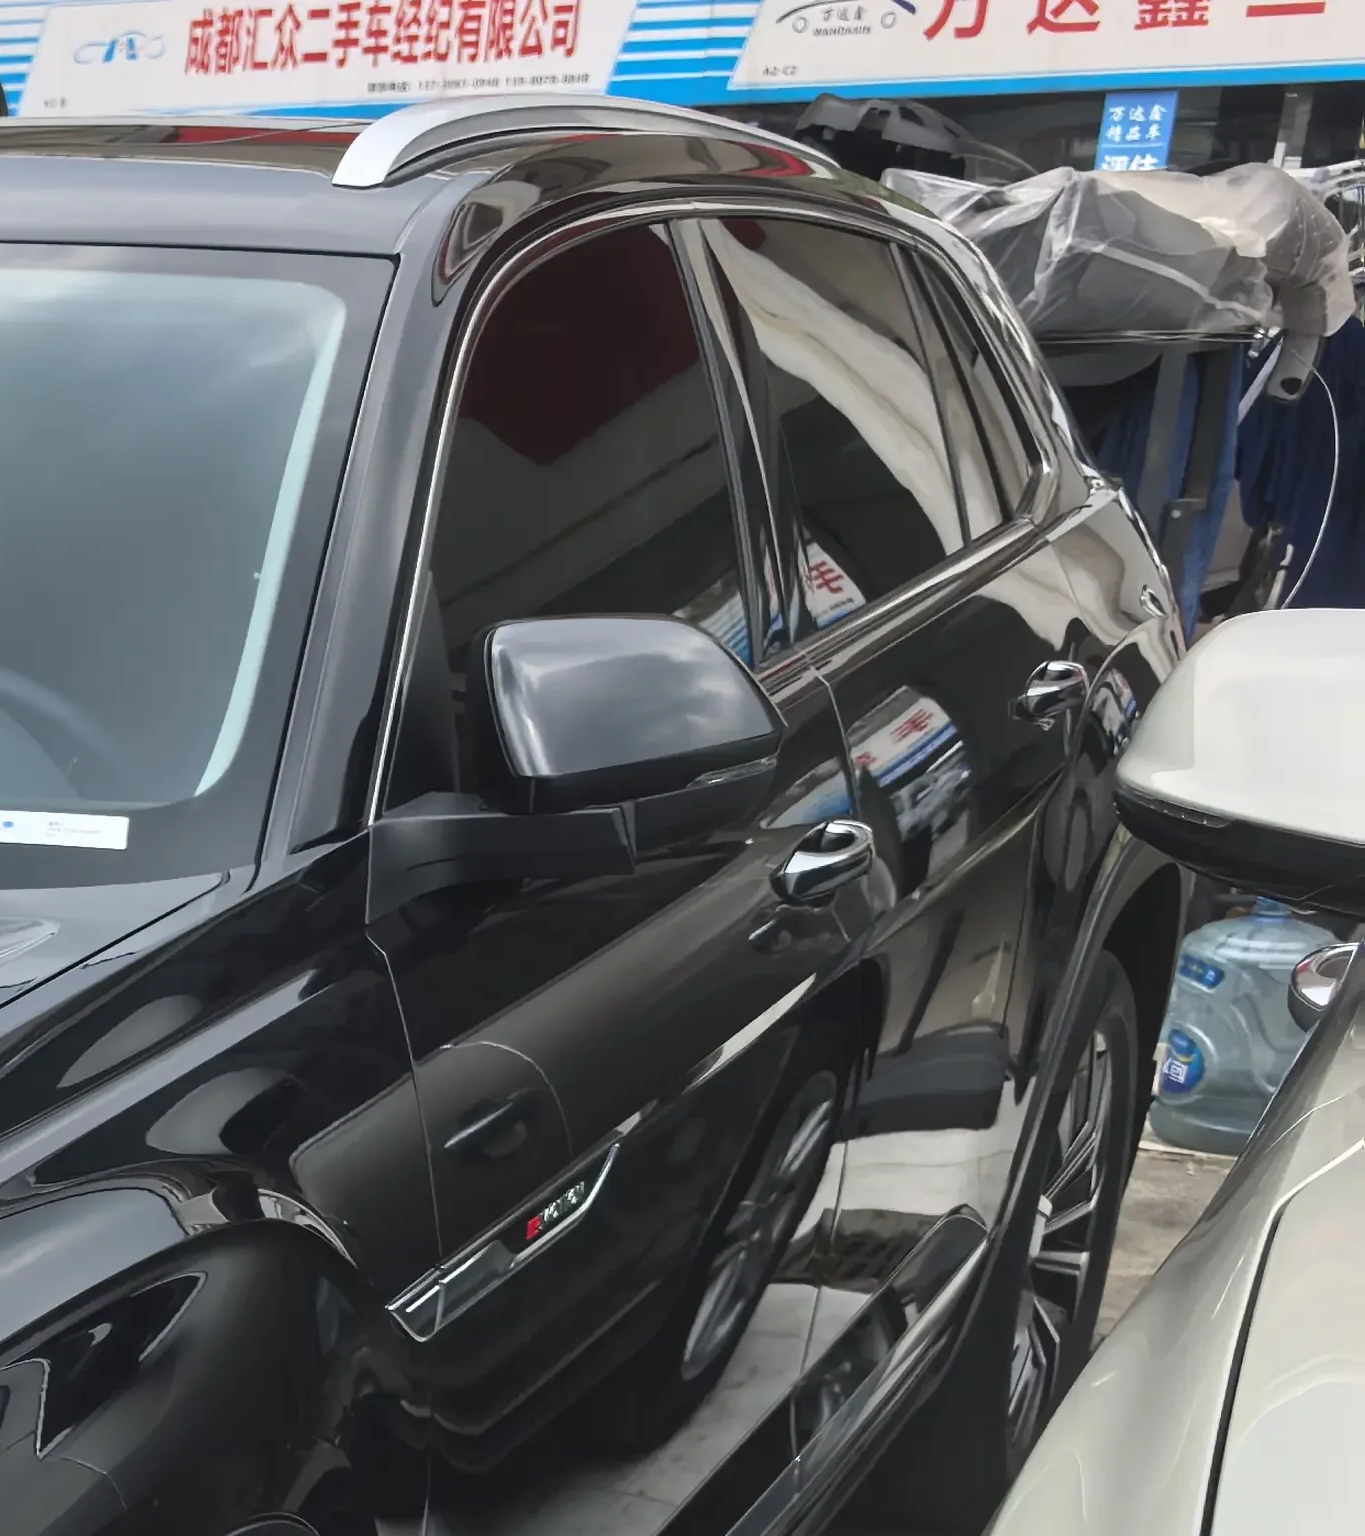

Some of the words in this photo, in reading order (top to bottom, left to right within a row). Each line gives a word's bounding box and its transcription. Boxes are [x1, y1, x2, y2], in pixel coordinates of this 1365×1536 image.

[185, 0, 580, 75] 成都汇众二手车经纪有限公司
